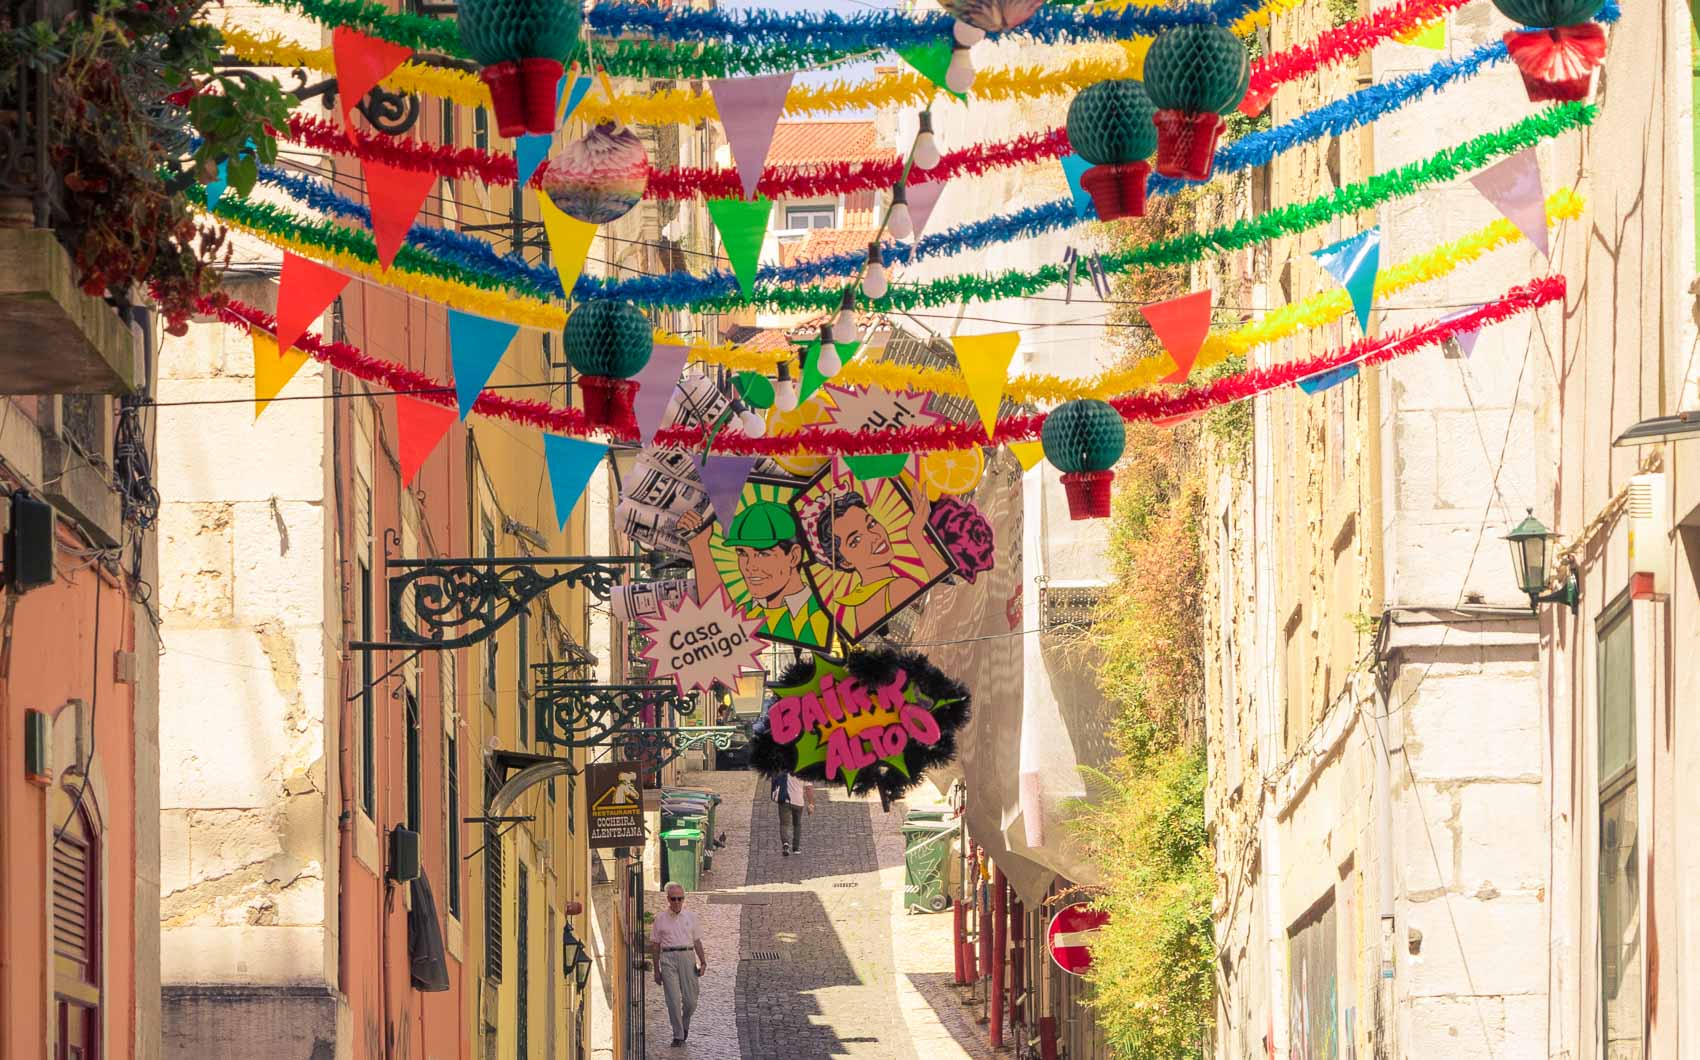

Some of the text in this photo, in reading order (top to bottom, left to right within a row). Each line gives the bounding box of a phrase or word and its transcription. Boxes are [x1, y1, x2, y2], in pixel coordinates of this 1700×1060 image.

[669, 622, 721, 650] Casa
[671, 623, 749, 670] comigo!
[825, 723, 908, 780] ALTO
[592, 809, 641, 817] RESTAURANTE
[597, 816, 636, 827] COCHEIRA
[592, 827, 642, 839] ALENTEJANA
